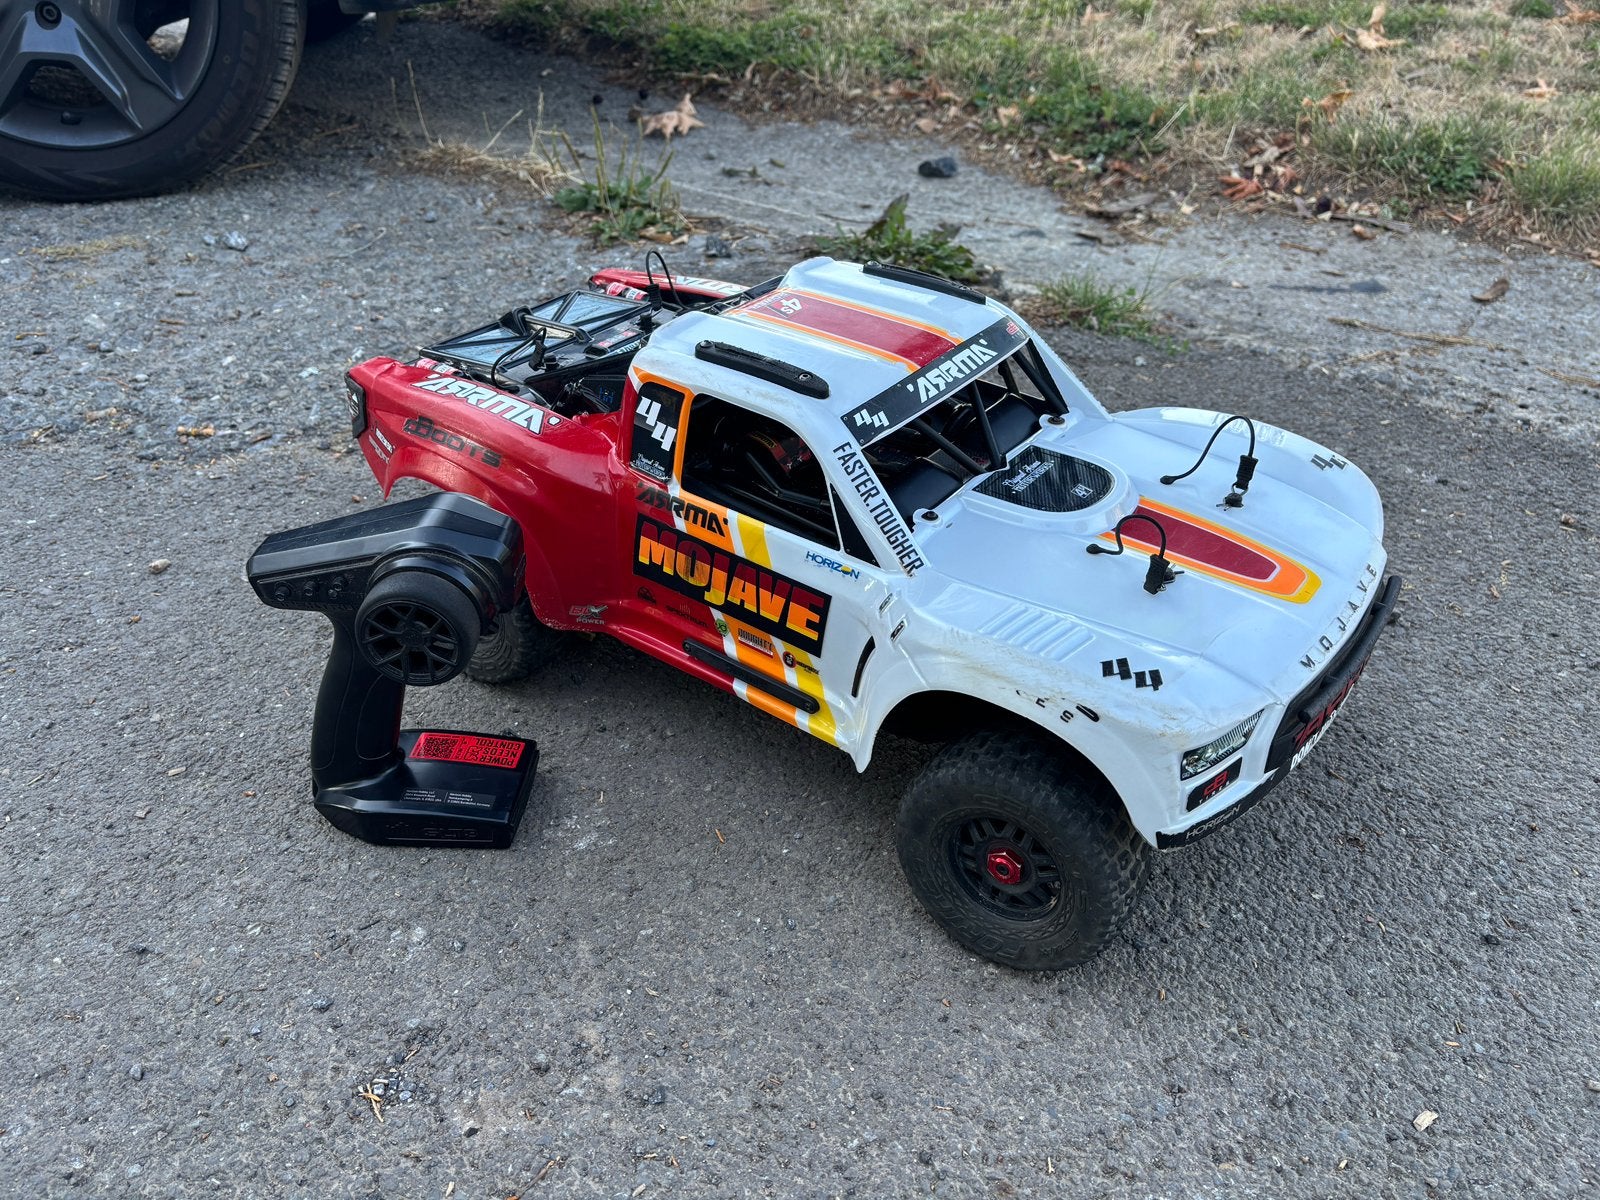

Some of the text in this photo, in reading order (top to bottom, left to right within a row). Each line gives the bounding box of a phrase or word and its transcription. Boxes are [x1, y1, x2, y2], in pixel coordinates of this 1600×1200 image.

[635, 395, 677, 452] 44
[853, 408, 890, 428] 44
[638, 520, 825, 641] MOJAVE
[805, 550, 860, 580] HORIZON
[1299, 563, 1377, 669] MOJAVE
[1099, 657, 1164, 692] 44
[474, 738, 522, 751] CONTROL
[479, 754, 515, 767] POWER
[483, 747, 519, 758] NEEDS
[1185, 804, 1241, 840] HORIZON
